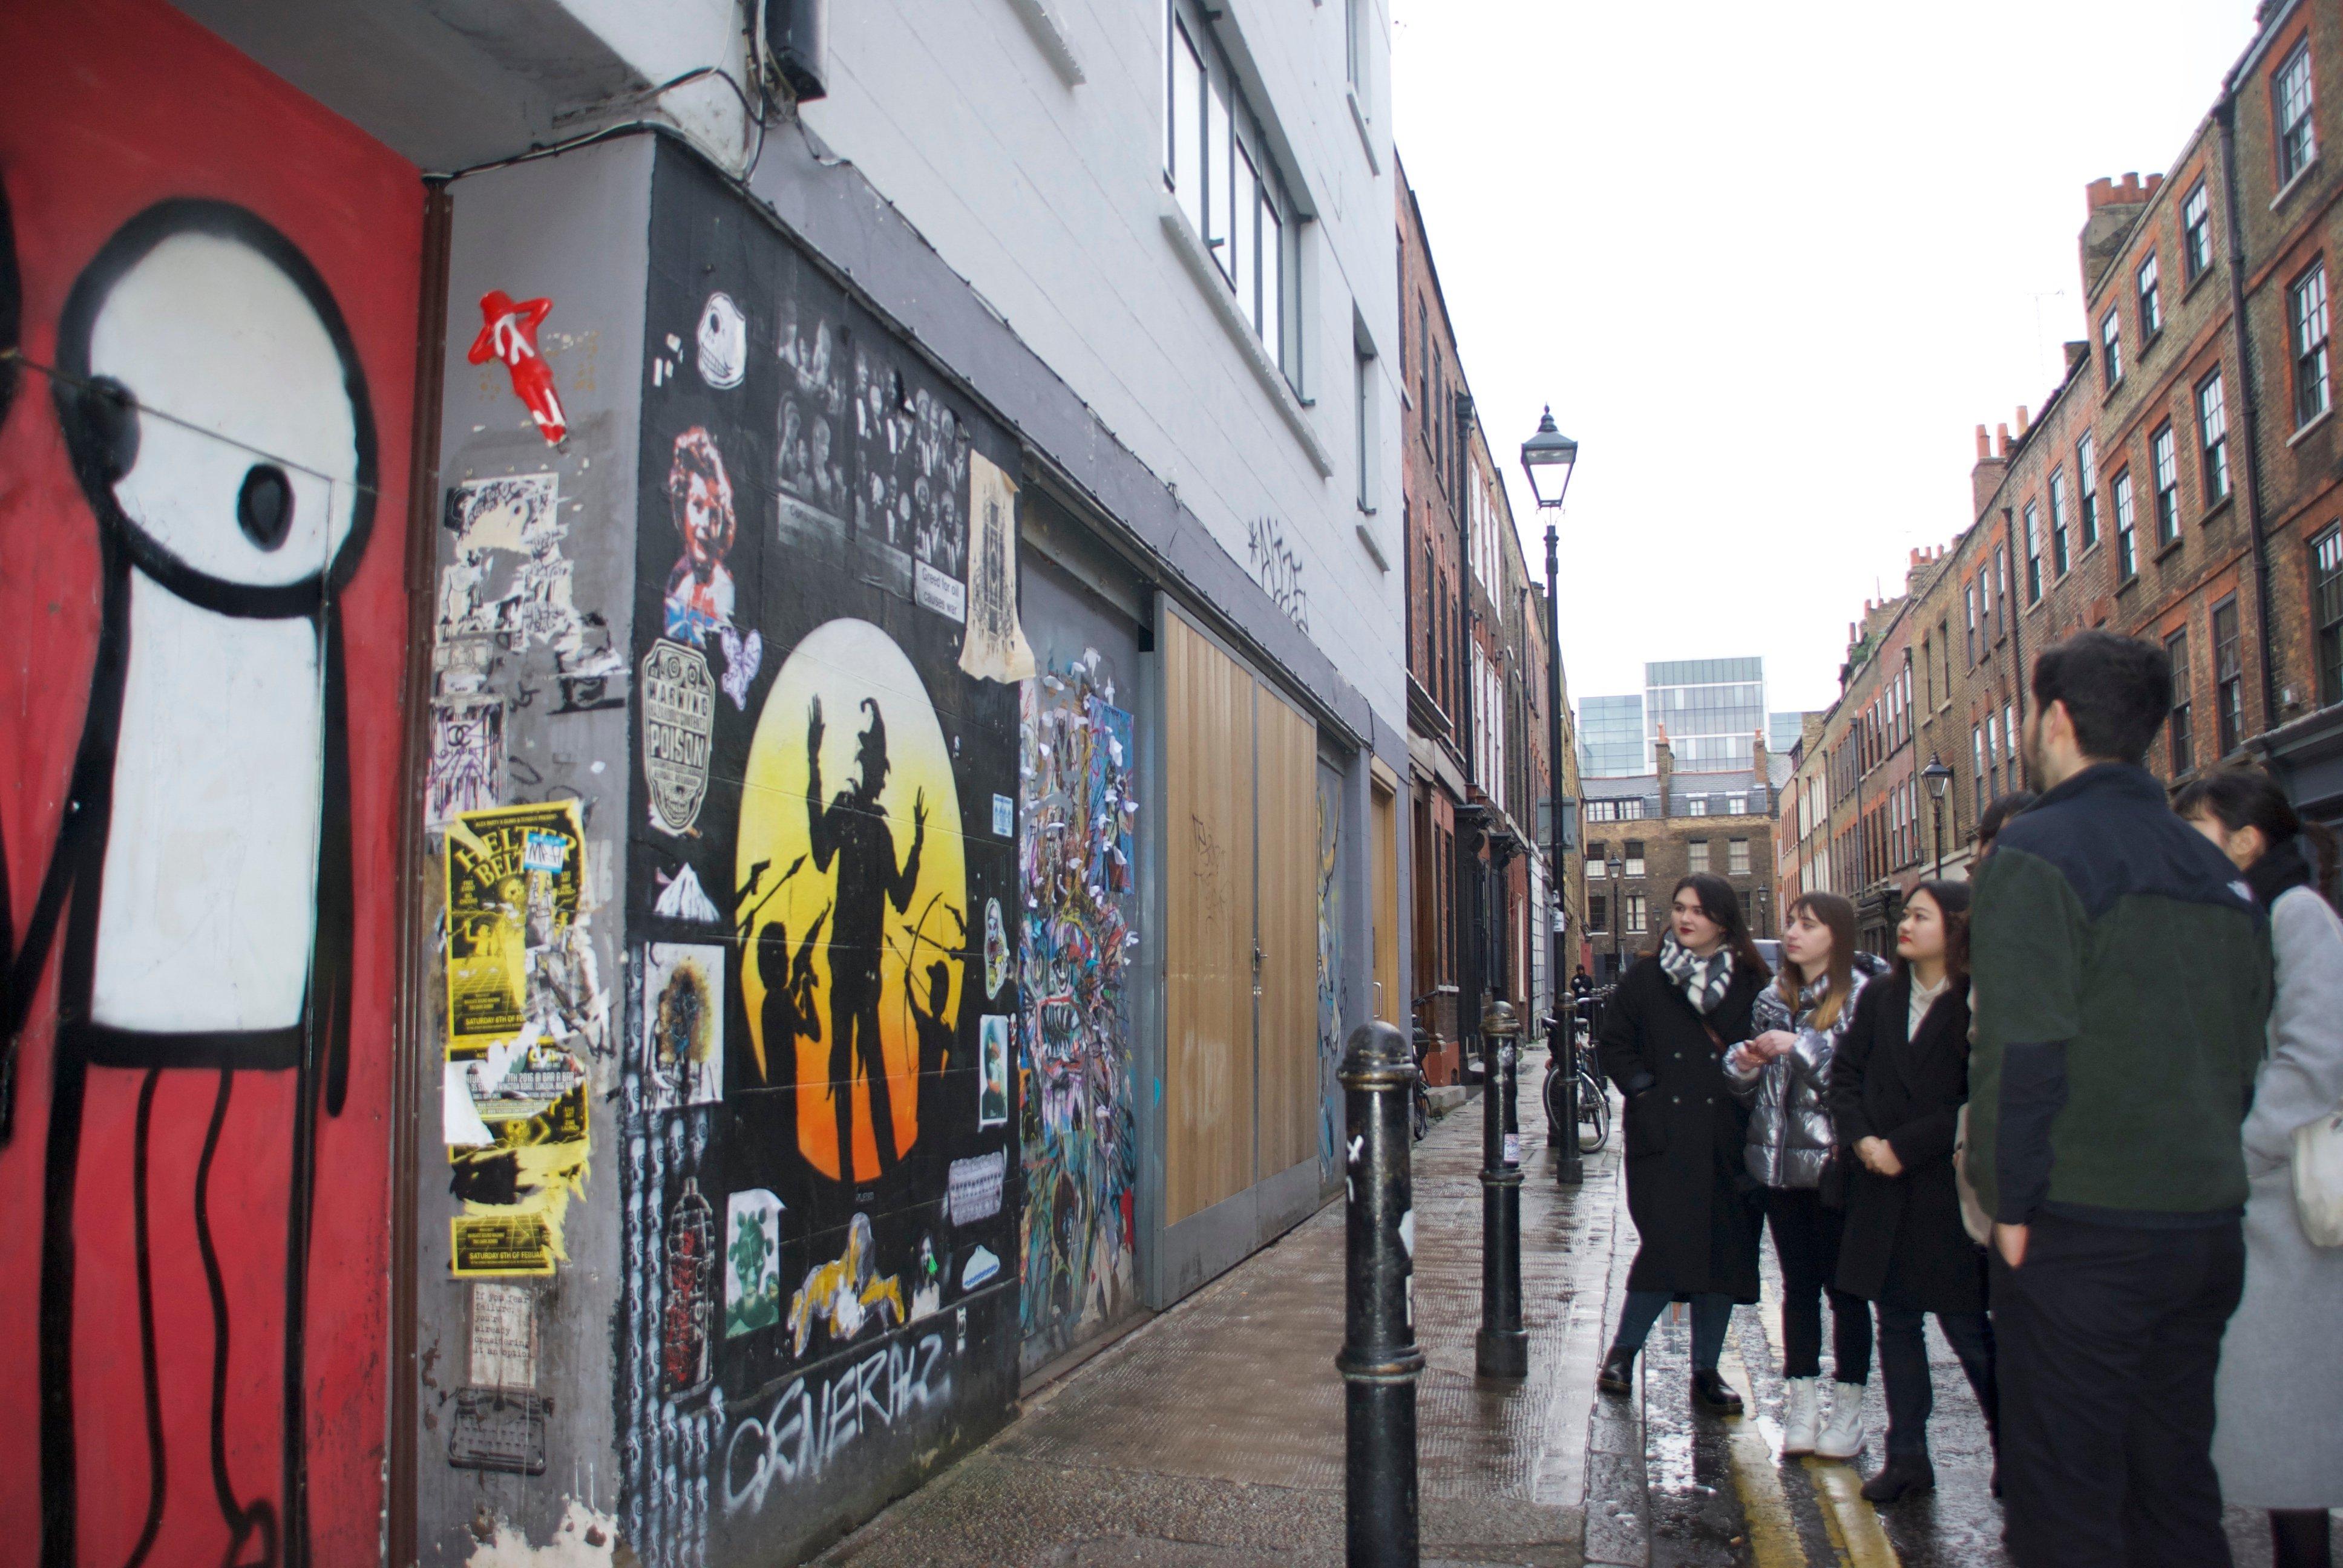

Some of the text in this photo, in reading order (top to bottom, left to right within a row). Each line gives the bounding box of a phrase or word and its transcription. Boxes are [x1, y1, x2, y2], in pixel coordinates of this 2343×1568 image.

[922, 567, 960, 597] Greed for oil
[923, 590, 957, 616] causes war
[649, 680, 708, 716] WARNING
[650, 723, 704, 767] POISON
[466, 1016, 495, 1026] SATURDAY
[519, 1072, 534, 1083] 2016
[476, 1290, 531, 1304] If you fear
[474, 1314, 503, 1323] you're
[474, 1324, 511, 1336] already
[474, 1336, 529, 1348] considering
[474, 1345, 483, 1354] it
